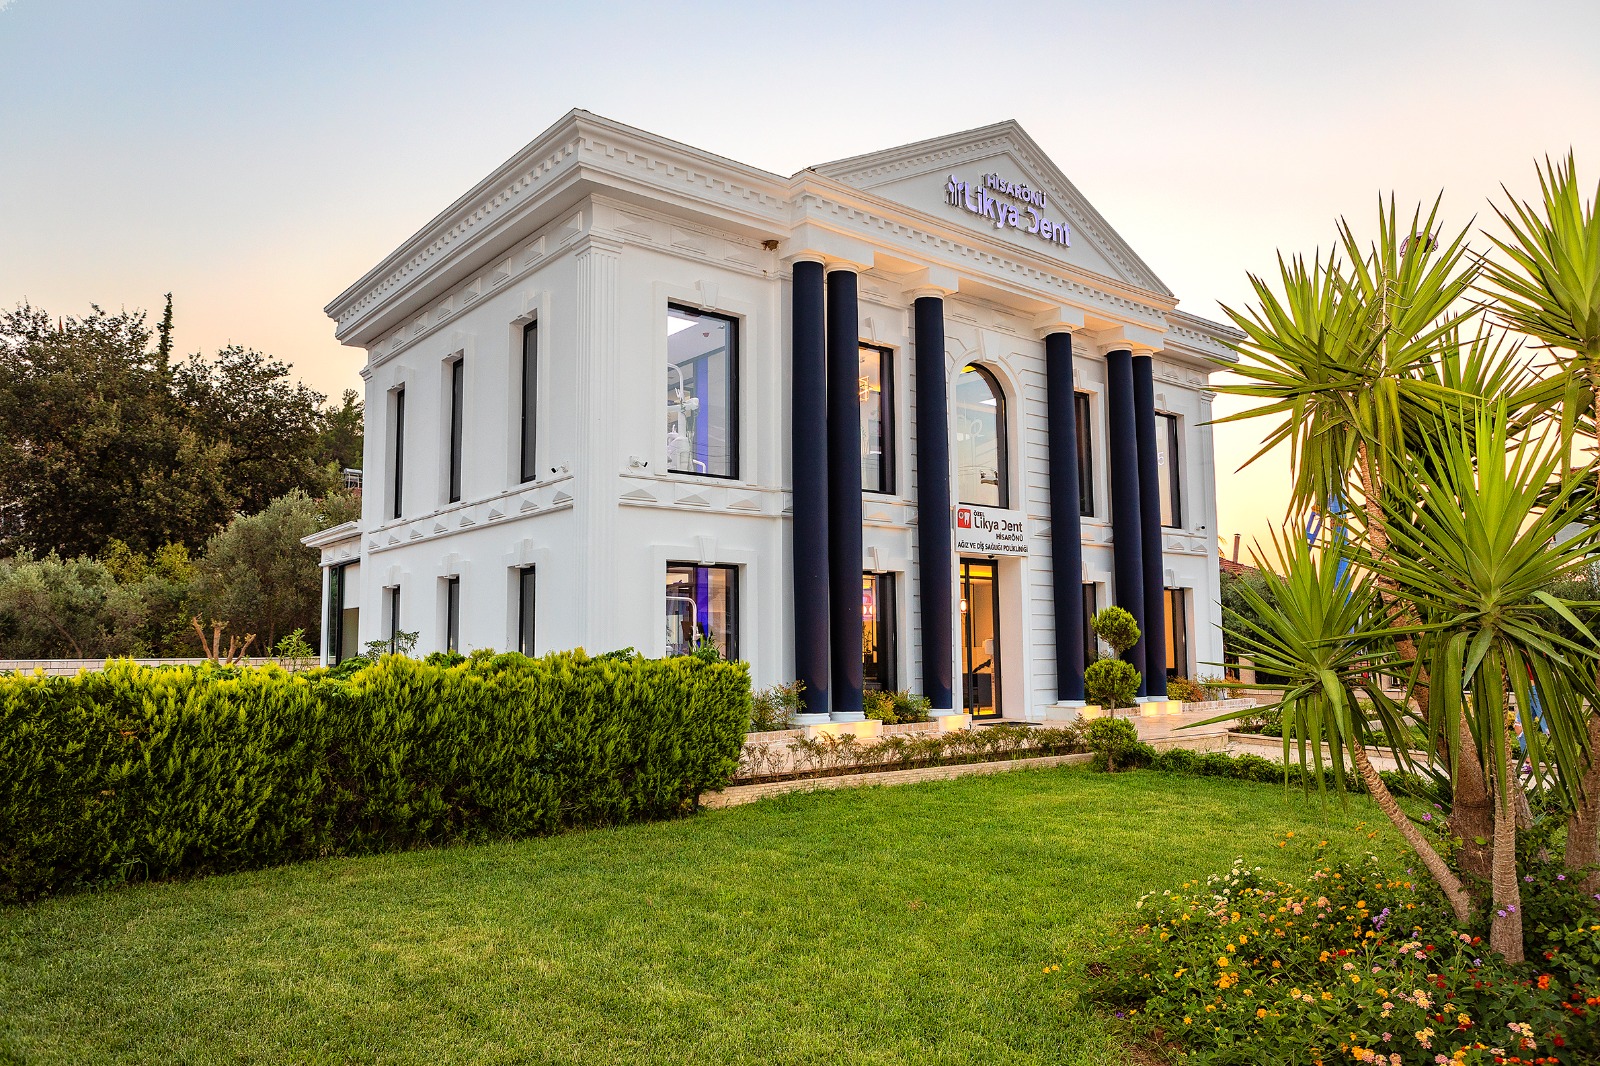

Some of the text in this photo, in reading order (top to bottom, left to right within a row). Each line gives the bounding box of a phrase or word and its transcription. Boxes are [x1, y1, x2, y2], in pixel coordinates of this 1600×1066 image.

[985, 173, 1046, 209] HİSARÖNÜ
[965, 181, 1071, 248] Likya Dent
[974, 516, 1023, 532] Likya Dent
[996, 532, 1024, 542] HİSARÖNÜ
[957, 540, 969, 549] AĞIZ
[969, 542, 976, 550] VE
[976, 541, 985, 552] DİŞ
